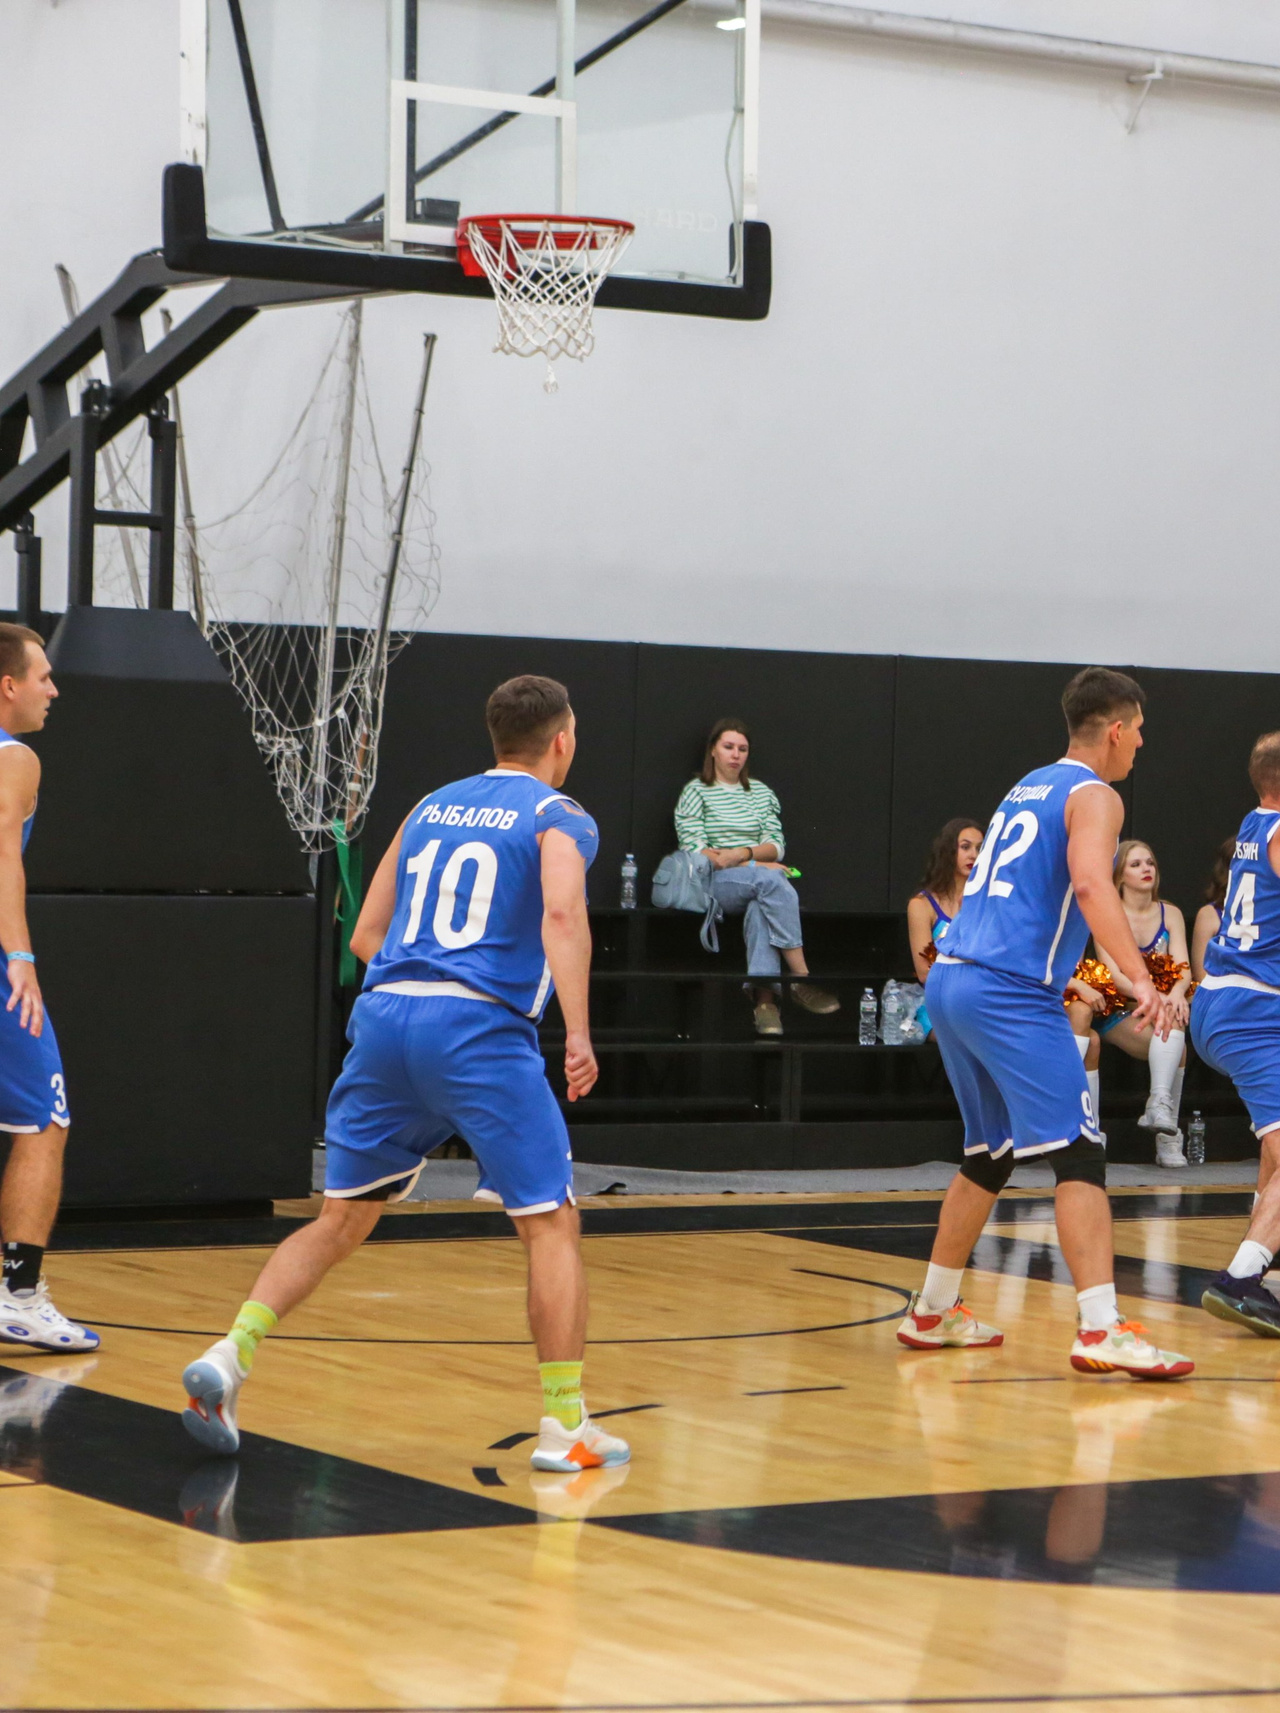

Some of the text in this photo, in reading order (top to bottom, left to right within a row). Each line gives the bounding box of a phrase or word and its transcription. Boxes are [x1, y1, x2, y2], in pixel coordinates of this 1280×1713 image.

[416, 804, 519, 830] РЫБАЛОВ
[402, 839, 498, 950] 10
[1219, 869, 1259, 952] 4
[50, 1073, 67, 1114] 3
